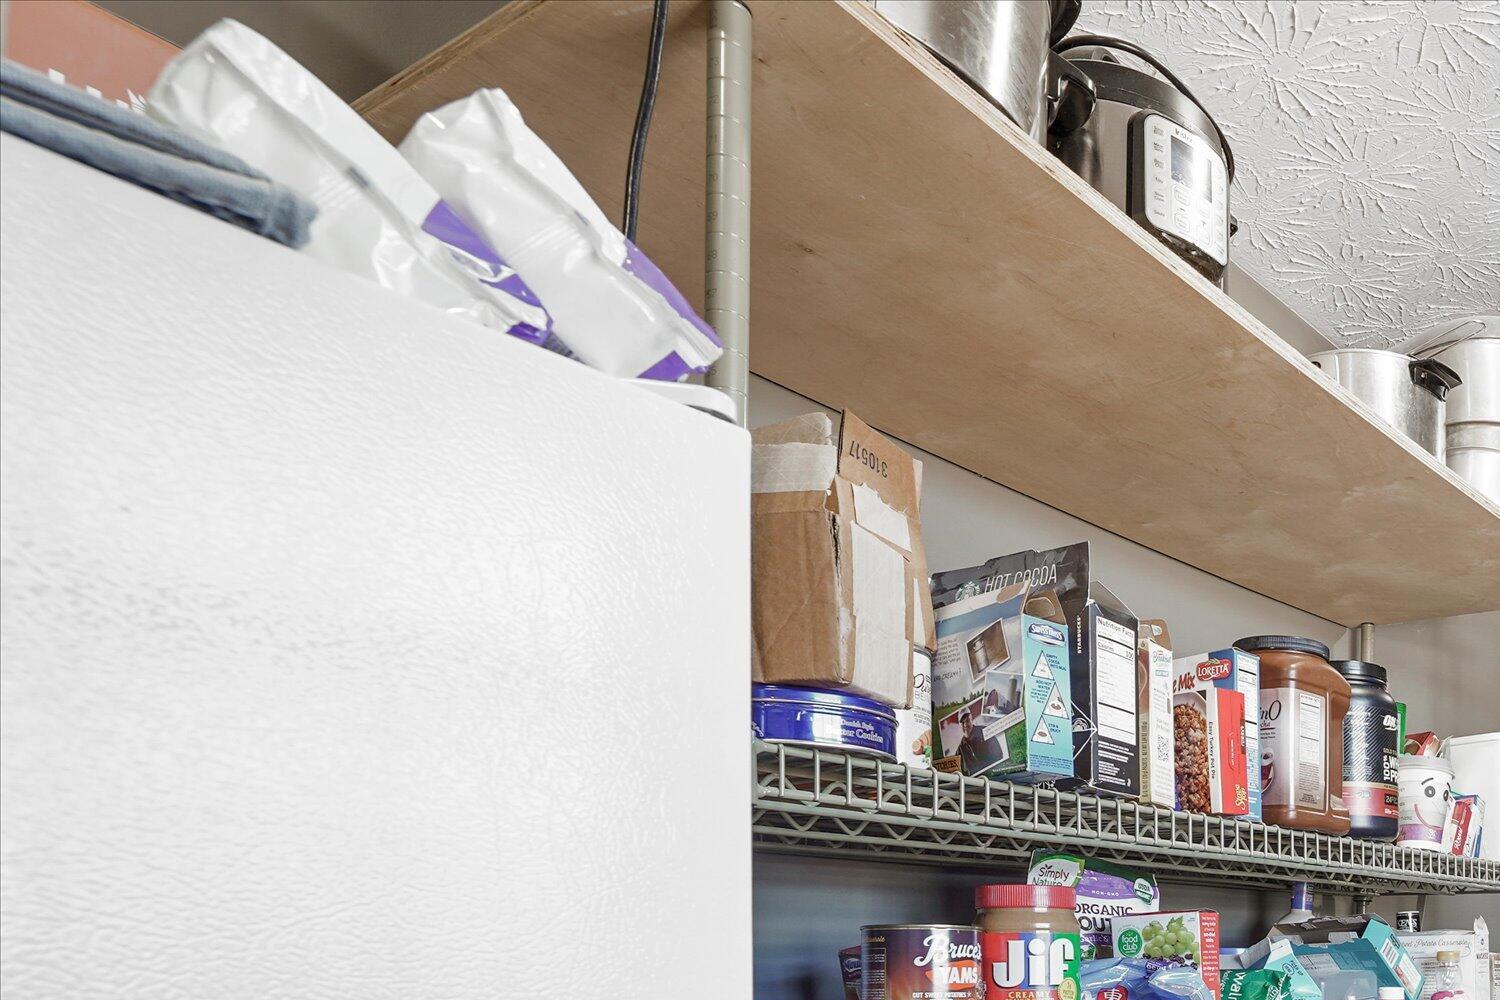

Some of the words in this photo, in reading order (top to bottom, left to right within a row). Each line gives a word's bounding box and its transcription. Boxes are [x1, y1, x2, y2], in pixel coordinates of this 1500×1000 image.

[849, 440, 888, 478] 310517
[985, 573, 1012, 594] HOT
[1014, 563, 1057, 588] COCOA
[1198, 664, 1230, 677] LORETTA
[1179, 672, 1195, 690] Mix
[856, 729, 884, 743] Cookies
[1039, 864, 1069, 882] Simply
[1121, 934, 1138, 942] food
[1122, 942, 1138, 950] club
[914, 933, 982, 967] Bruce's
[993, 938, 1074, 988] Jif
[939, 967, 978, 984] YAMS
[1008, 991, 1050, 999] CREAMY
